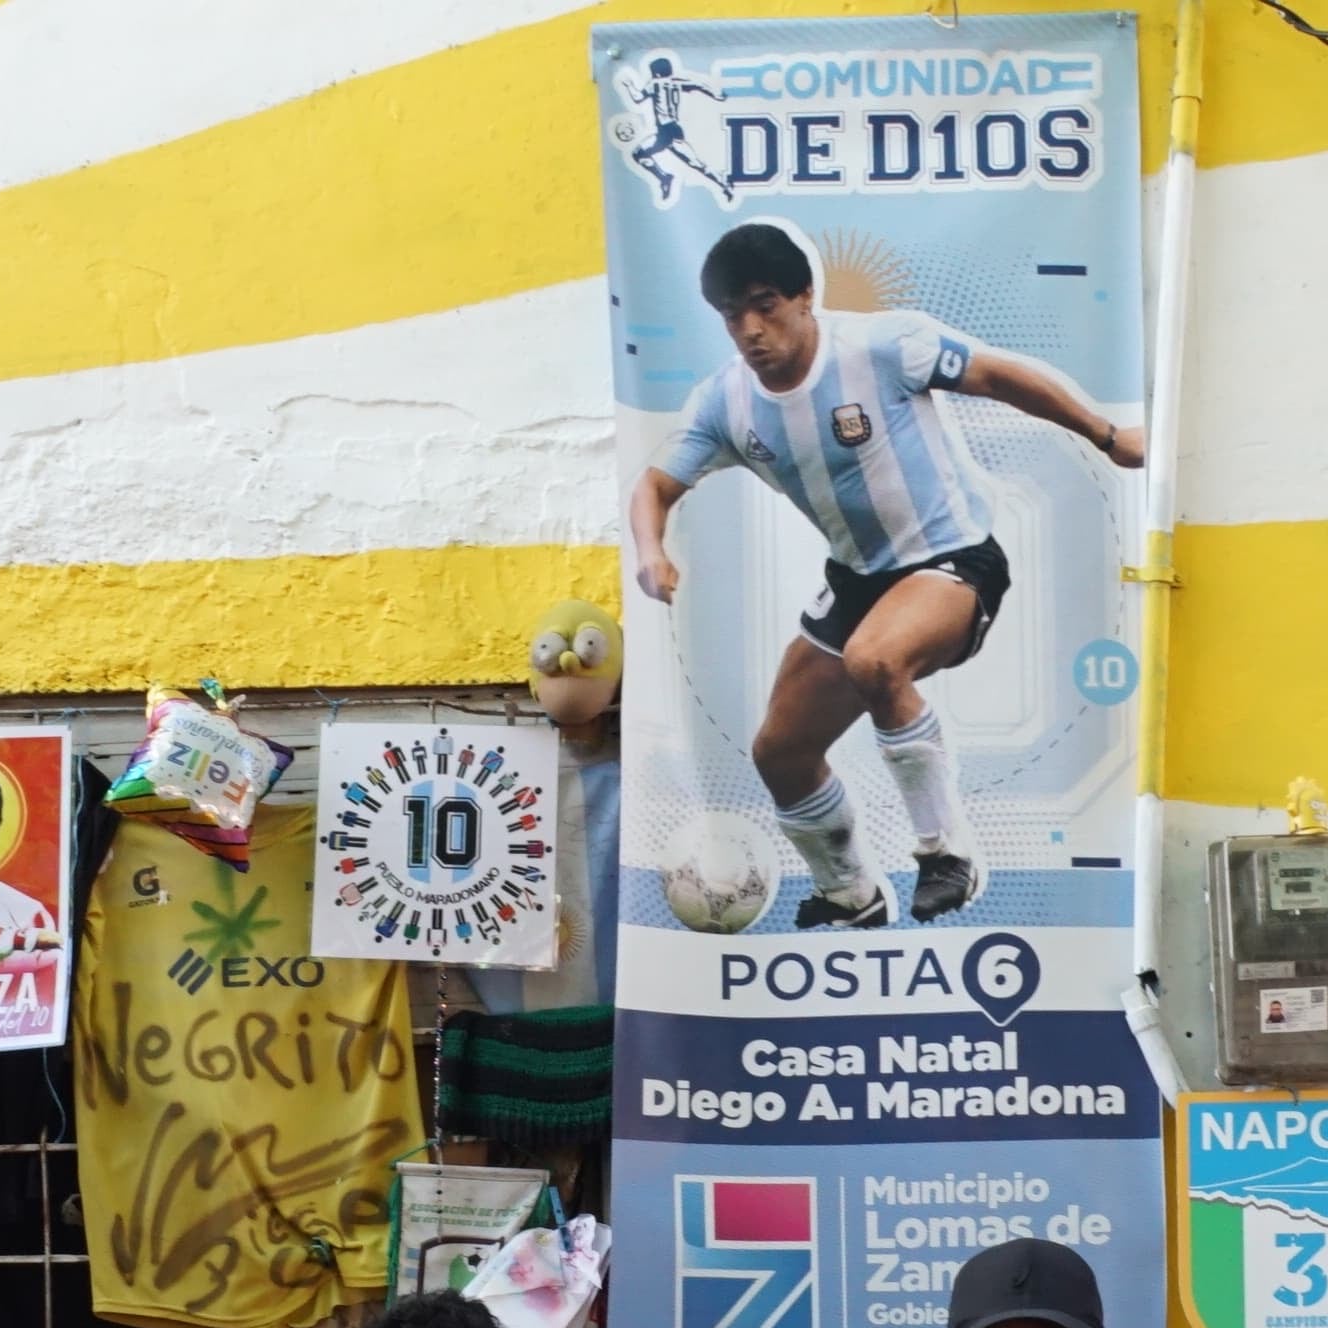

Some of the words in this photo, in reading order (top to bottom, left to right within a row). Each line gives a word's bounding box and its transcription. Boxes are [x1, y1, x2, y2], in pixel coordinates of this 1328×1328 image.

[752, 57, 1063, 101] COMUNIDAD
[724, 114, 843, 184] DE
[1082, 655, 1127, 689] 10
[167, 740, 251, 807] Feliz
[403, 795, 483, 870] 10
[222, 955, 326, 988] EXO
[722, 947, 953, 1001] POSTA
[976, 944, 1025, 989] 6
[741, 1038, 866, 1078] Casa
[877, 1031, 1018, 1074] Natal
[640, 1079, 787, 1129] Diego
[798, 1083, 854, 1121] A.
[866, 1076, 1127, 1121] Maradona
[863, 1172, 1050, 1209] Municipio
[864, 1209, 1033, 1250] Lomas
[1046, 1205, 1112, 1247] de
[1272, 1232, 1328, 1308] 3
[867, 1302, 949, 1325] Gobie
